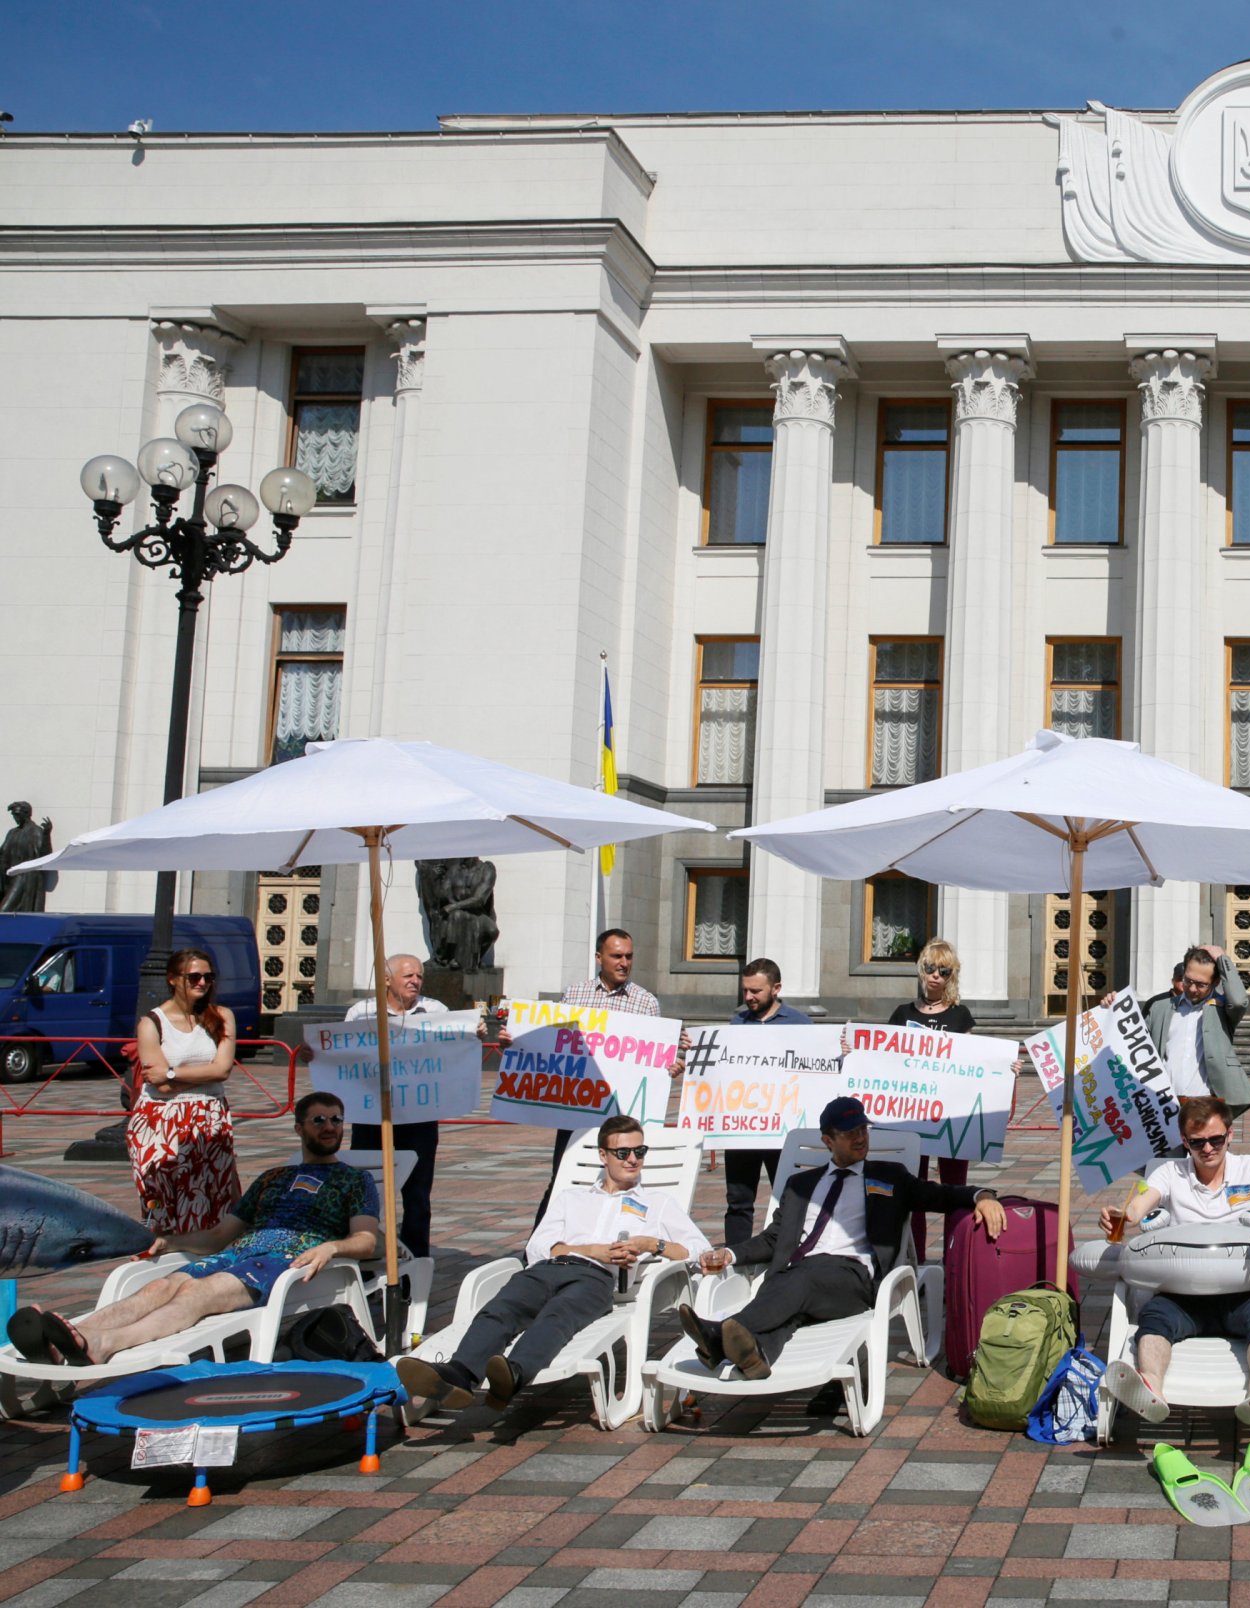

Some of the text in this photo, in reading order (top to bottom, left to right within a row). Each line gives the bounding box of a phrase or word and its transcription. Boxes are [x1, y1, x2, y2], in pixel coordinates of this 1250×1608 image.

[511, 1002, 609, 1033] ТІЛЬКИ
[555, 1028, 678, 1069] РЕФОРМИ
[854, 1029, 953, 1059] ПРАЦЮЙ
[1112, 994, 1163, 1084] РЕЙСИ
[503, 1048, 587, 1078] ТІЛЬКИ
[904, 1057, 985, 1078] СТАБІЛЬНО
[1031, 1041, 1065, 1090] 2431
[495, 1071, 612, 1108] ХАРДКОР
[682, 1113, 781, 1131] А НЕ БУКСУЙ
